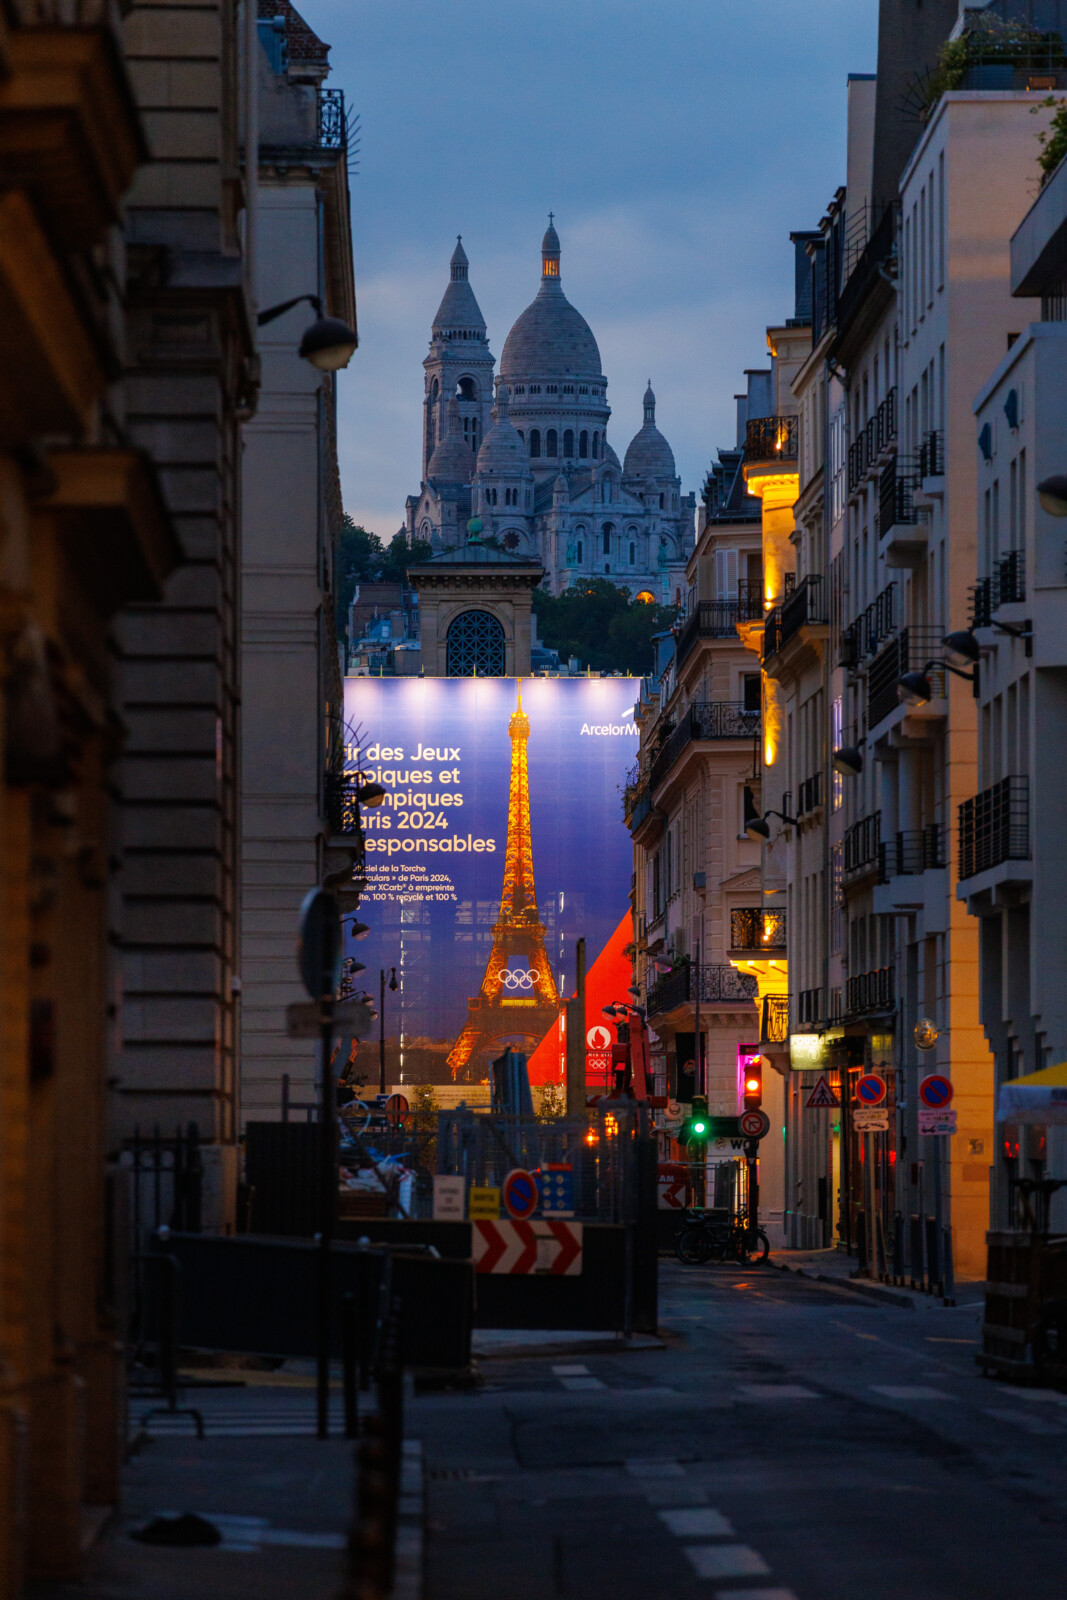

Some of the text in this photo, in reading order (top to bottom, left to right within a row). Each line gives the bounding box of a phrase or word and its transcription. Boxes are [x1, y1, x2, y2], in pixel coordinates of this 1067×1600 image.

[366, 743, 404, 761] des
[410, 743, 461, 761] Jeux
[438, 768, 461, 784] et
[397, 811, 449, 829] 2024
[364, 833, 496, 857] esponsables
[379, 864, 390, 872] de
[391, 864, 399, 872] la
[400, 864, 426, 872] Torche
[398, 874, 409, 882] de
[410, 874, 429, 882] Paris
[430, 874, 452, 883] 2024,
[415, 884, 455, 893] empreinte
[372, 893, 387, 901] 100
[388, 893, 395, 901] %
[396, 893, 424, 902] recyclé
[425, 893, 434, 901] et
[435, 893, 449, 901] 100
[450, 893, 458, 901] %
